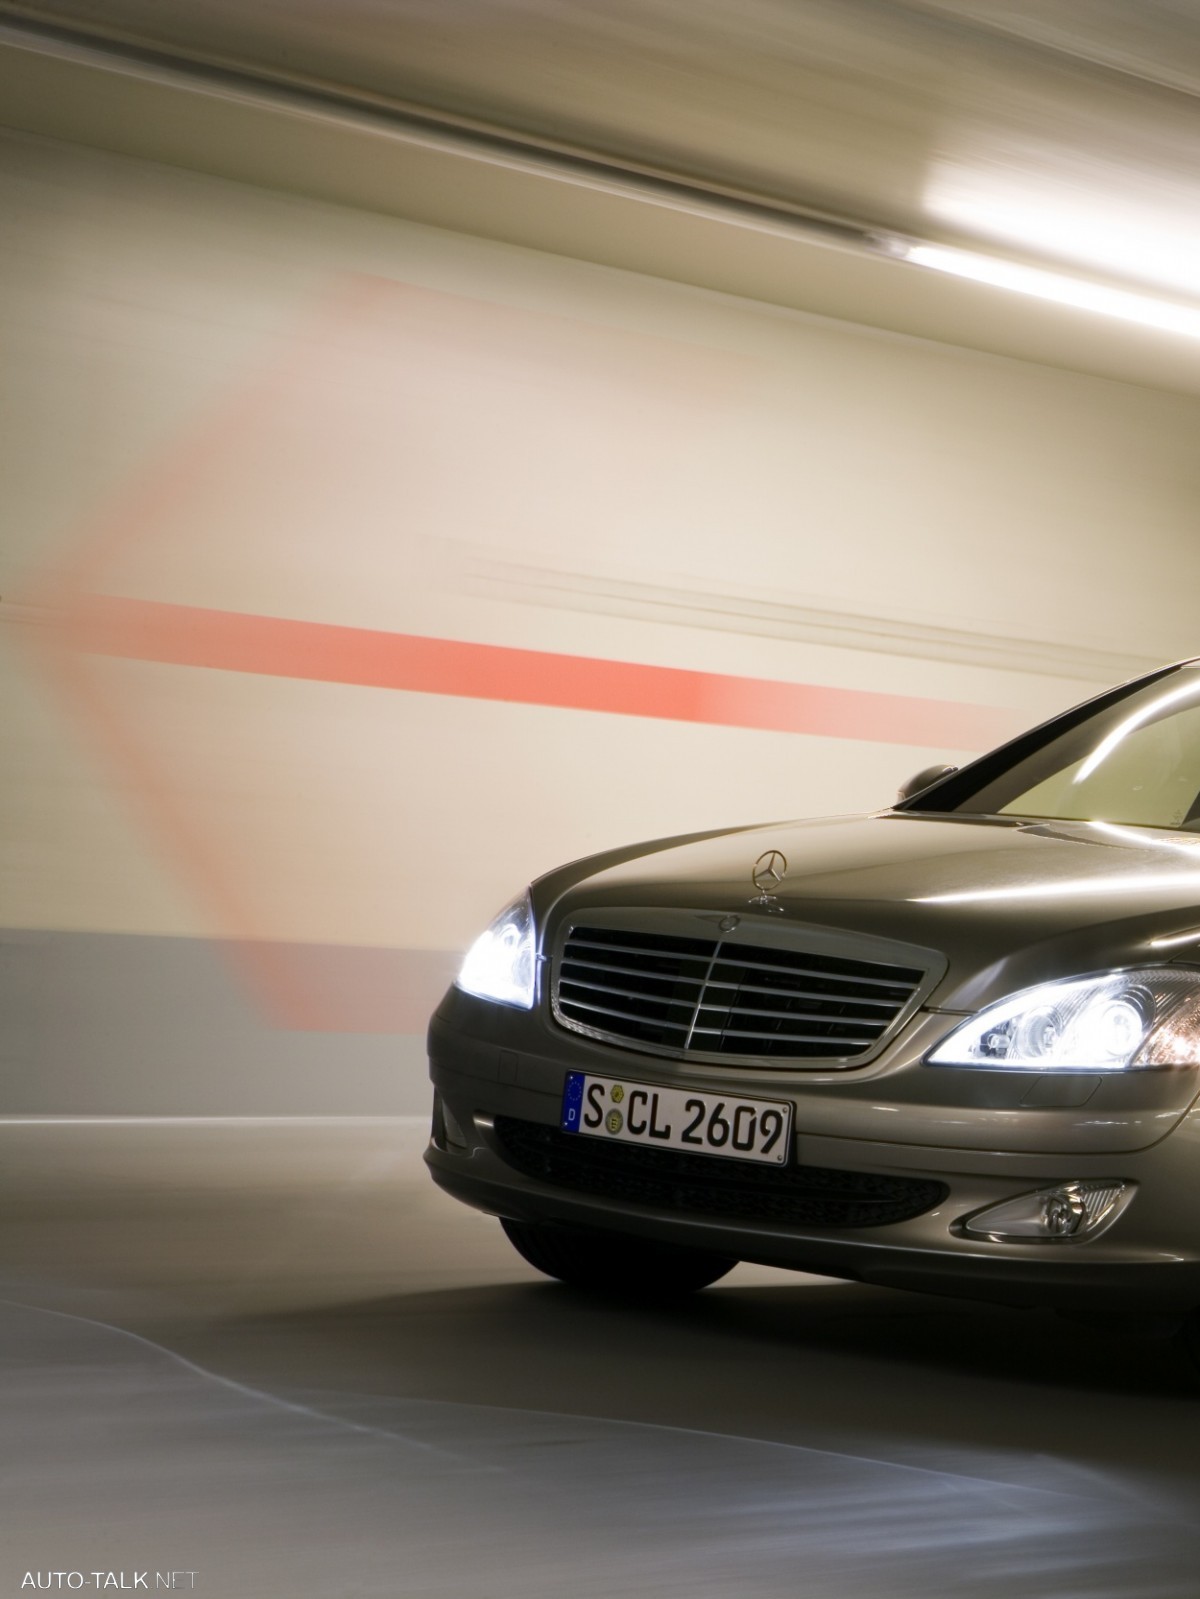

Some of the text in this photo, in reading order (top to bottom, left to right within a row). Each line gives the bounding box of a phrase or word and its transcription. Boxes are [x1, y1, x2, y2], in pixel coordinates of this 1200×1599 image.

[568, 1108, 576, 1121] D
[584, 1083, 783, 1154] S CL 2609
